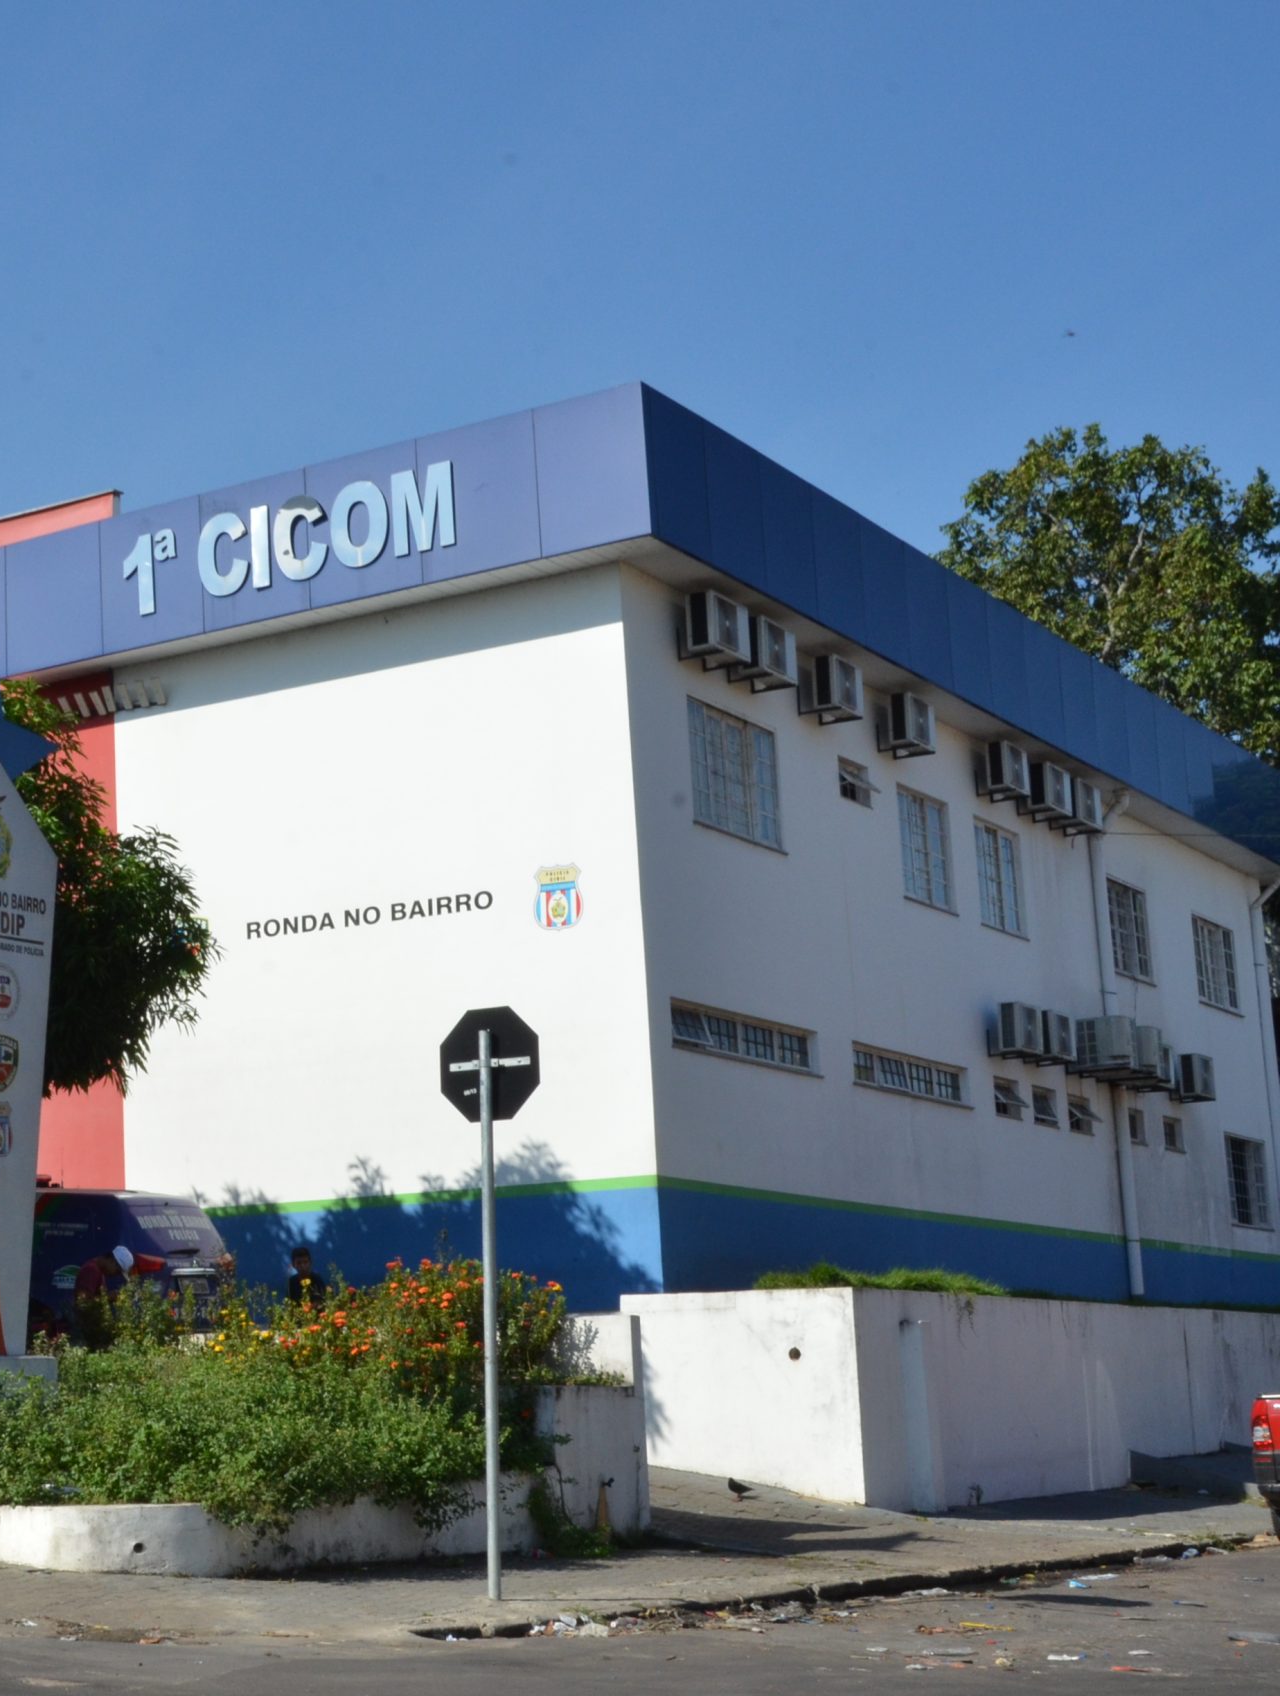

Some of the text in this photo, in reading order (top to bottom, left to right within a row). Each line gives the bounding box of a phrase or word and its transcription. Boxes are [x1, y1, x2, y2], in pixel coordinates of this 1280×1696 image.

[123, 460, 456, 616] 1ª CICOM
[11, 893, 47, 915] BAIRRO
[246, 890, 494, 940] RONDA NO BAIRRO
[0, 911, 25, 937] DIP
